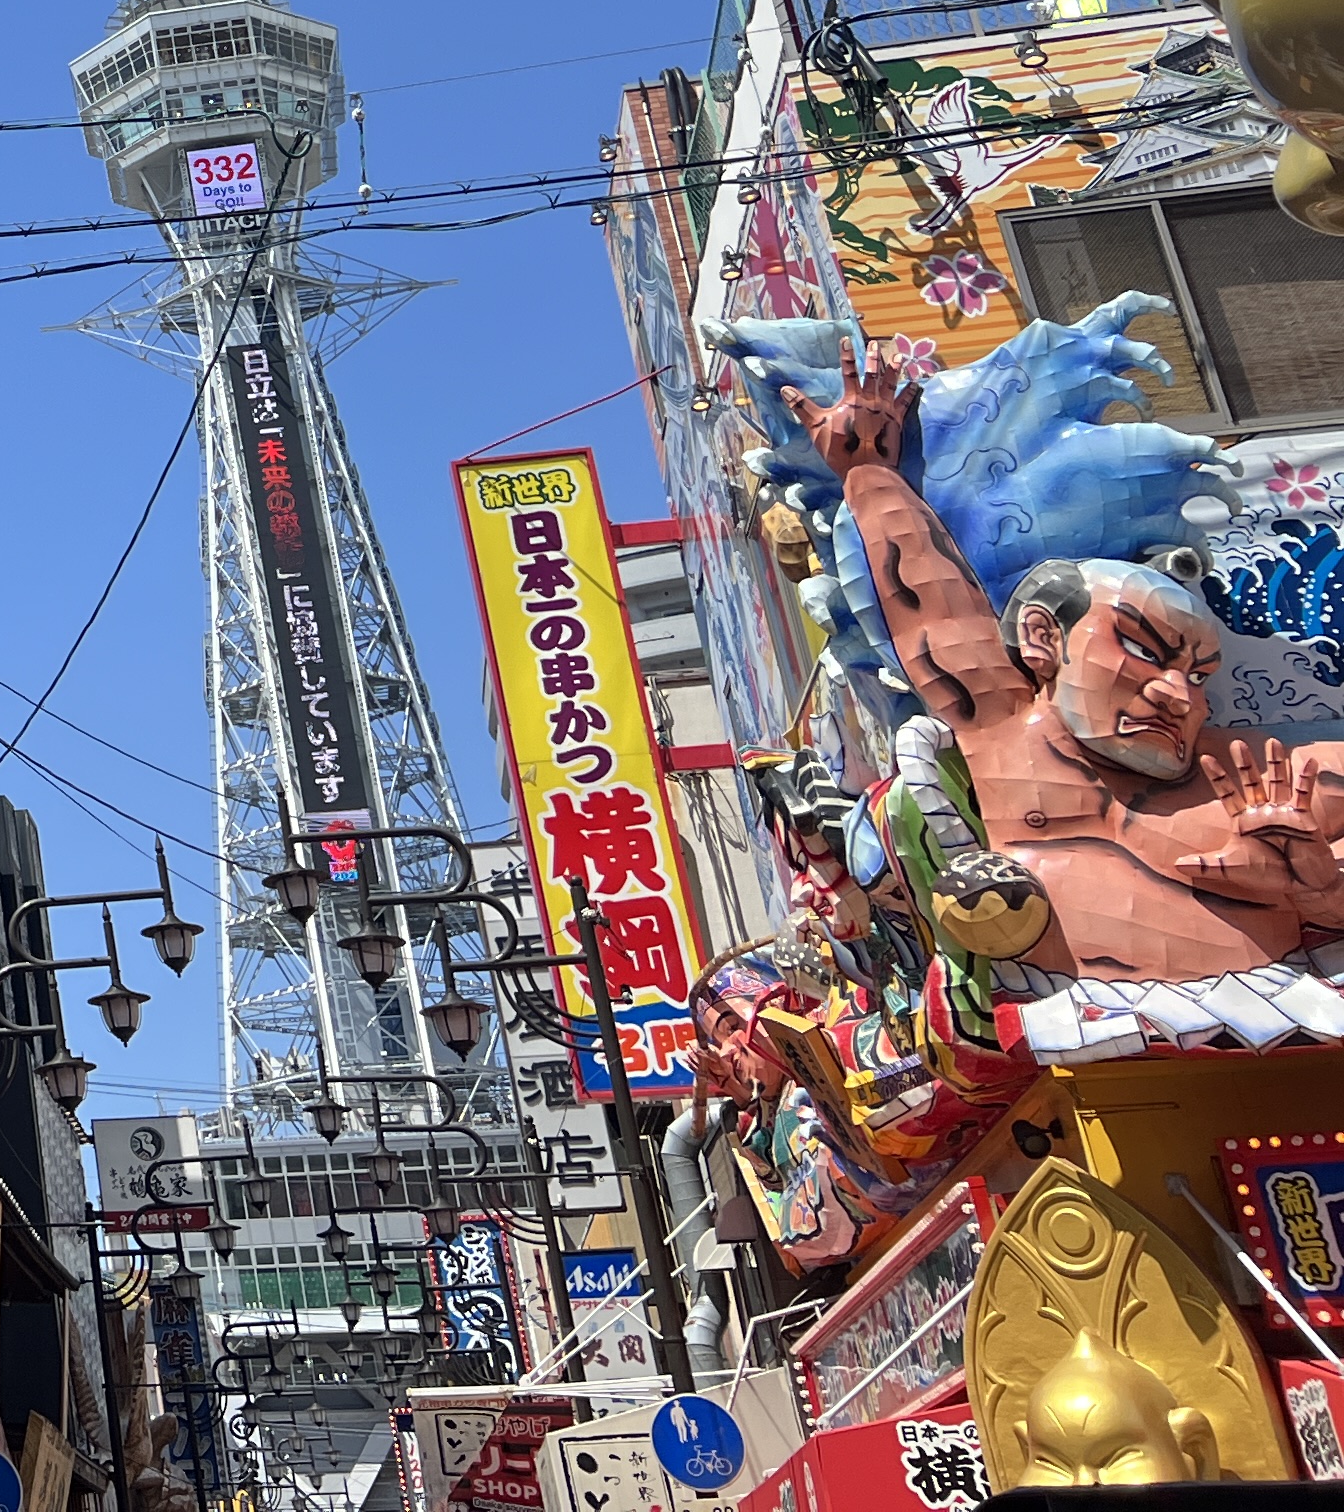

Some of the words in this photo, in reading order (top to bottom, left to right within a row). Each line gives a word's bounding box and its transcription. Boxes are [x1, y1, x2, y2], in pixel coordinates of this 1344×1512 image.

[193, 153, 256, 185] 332
[203, 185, 235, 197] Days
[238, 183, 252, 192] to
[192, 214, 270, 234] HITACH
[478, 468, 576, 510] 新世界
[511, 510, 615, 784] 日本一の串かつ
[542, 785, 691, 1009] 横綱
[1273, 1178, 1334, 1286] 新世界
[566, 1263, 633, 1294] Asahi
[473, 1478, 538, 1500] SHOP
[628, 1450, 659, 1504] 新世界
[910, 1443, 991, 1505] 横
